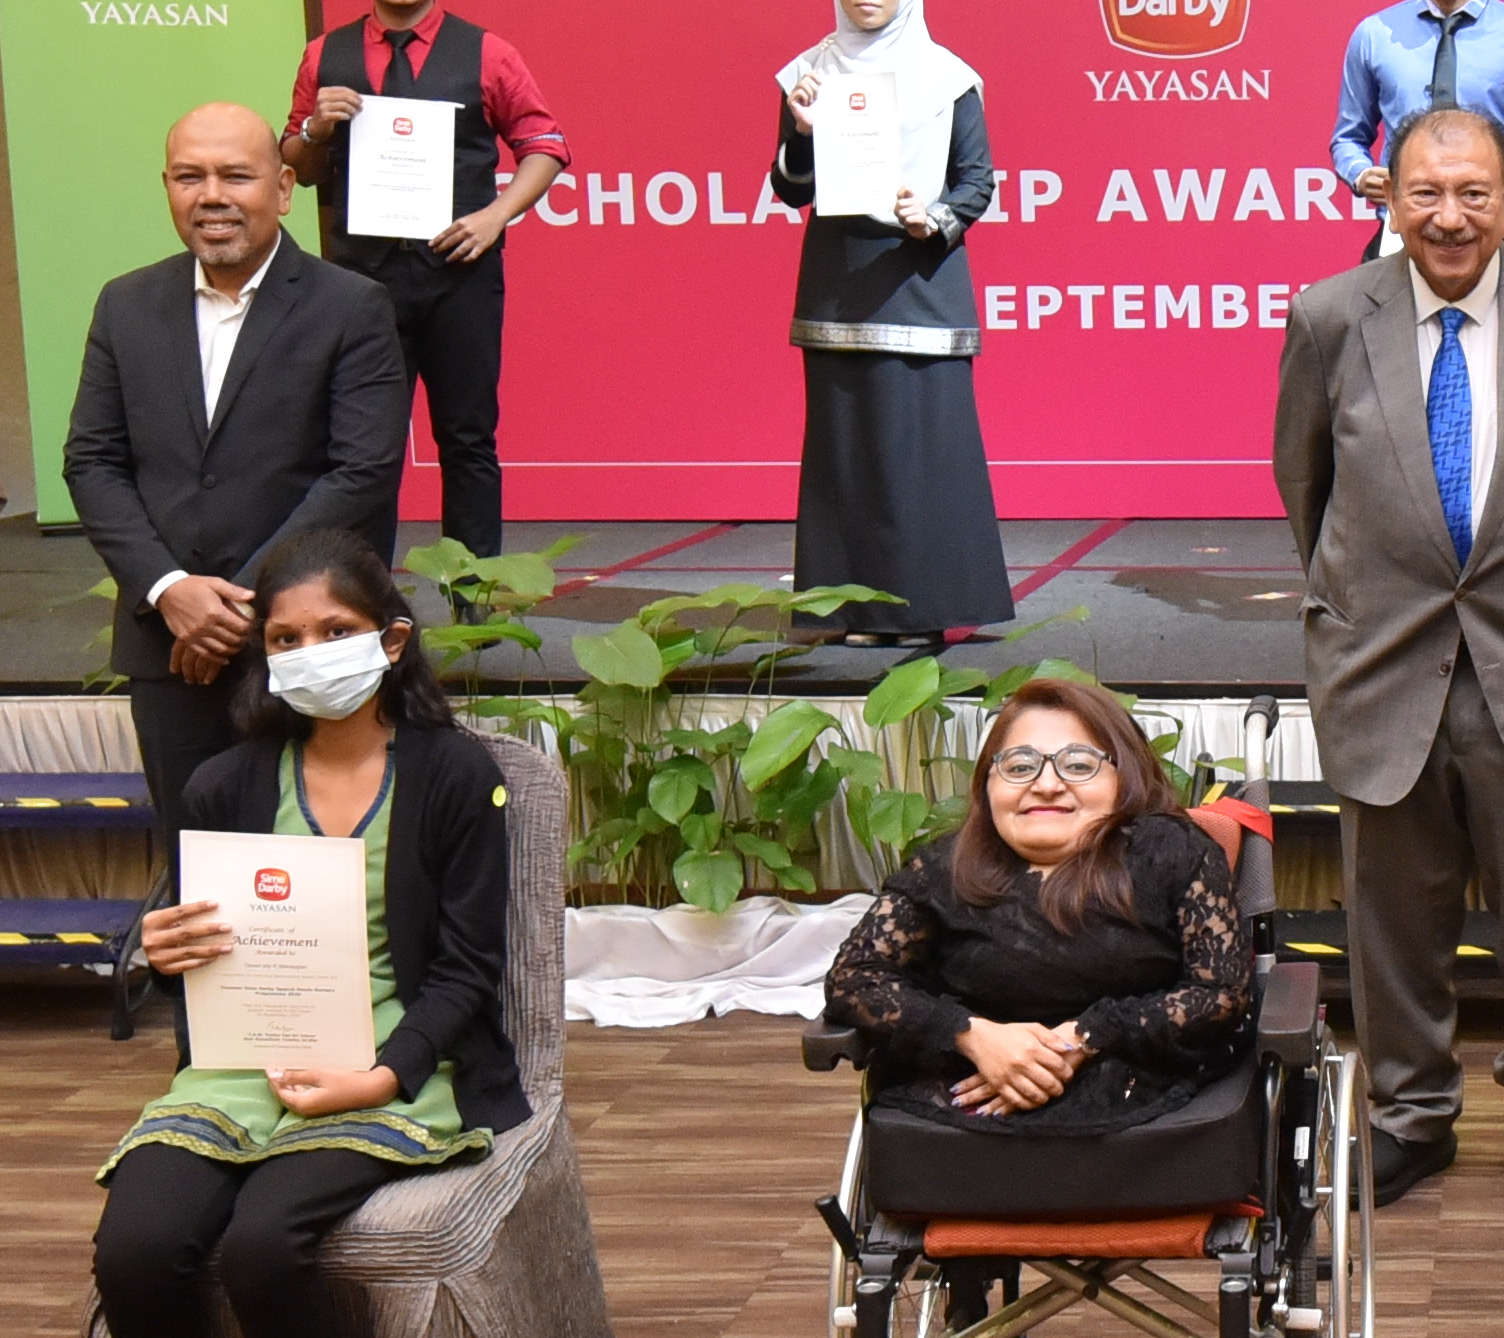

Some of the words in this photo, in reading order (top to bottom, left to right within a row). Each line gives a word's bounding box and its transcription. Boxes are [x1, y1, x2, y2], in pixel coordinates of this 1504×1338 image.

[80, 1, 229, 27] YAYASAN
[1084, 69, 1272, 102] YAYASAN
[984, 284, 1311, 329] EPTEMBE
[249, 904, 297, 913] YAYASAN
[232, 934, 318, 948] Achievement
